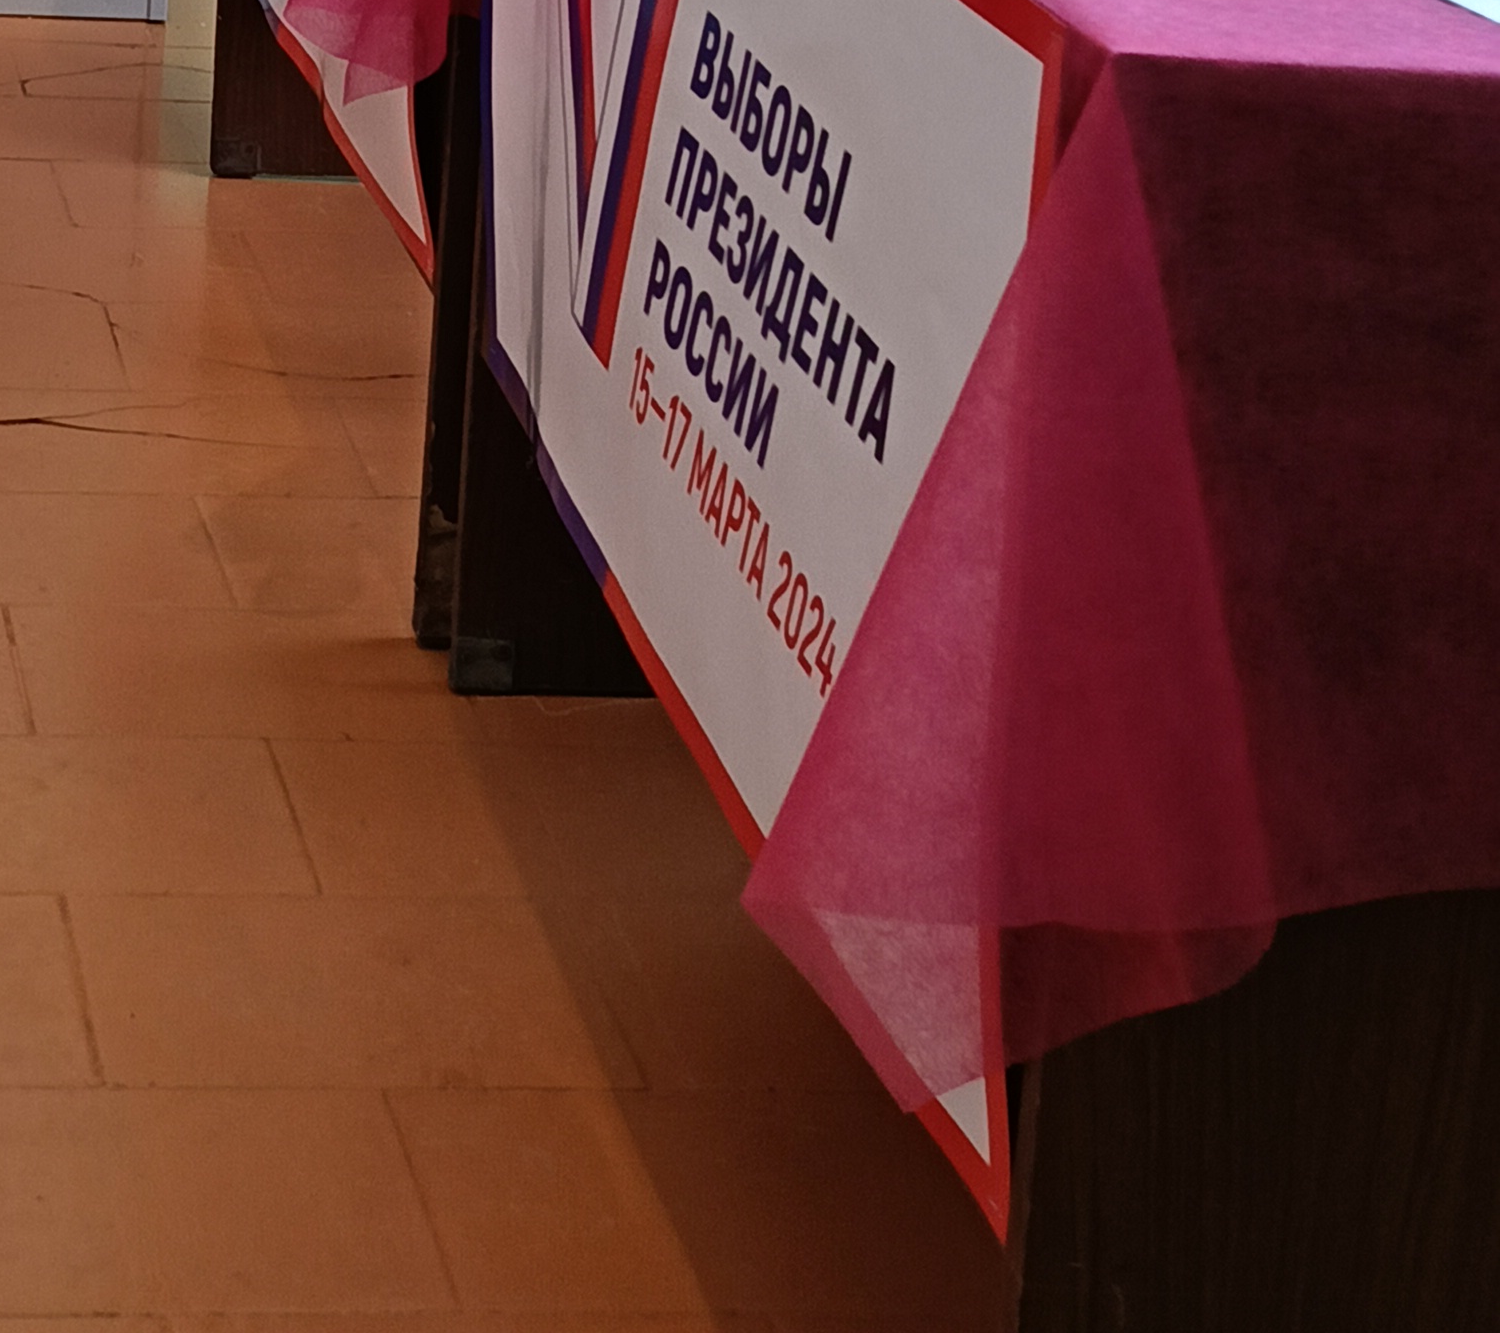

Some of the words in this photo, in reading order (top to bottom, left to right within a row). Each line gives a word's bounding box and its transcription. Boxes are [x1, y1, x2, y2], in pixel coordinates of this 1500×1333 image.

[690, 10, 852, 244] ВЫБОРЫ
[644, 237, 780, 470] РОССИИ
[665, 125, 896, 466] ПРЕЗИДЕНТА
[629, 346, 692, 471] 15–17
[687, 427, 771, 582] МАРТА
[766, 550, 836, 698] 2024
